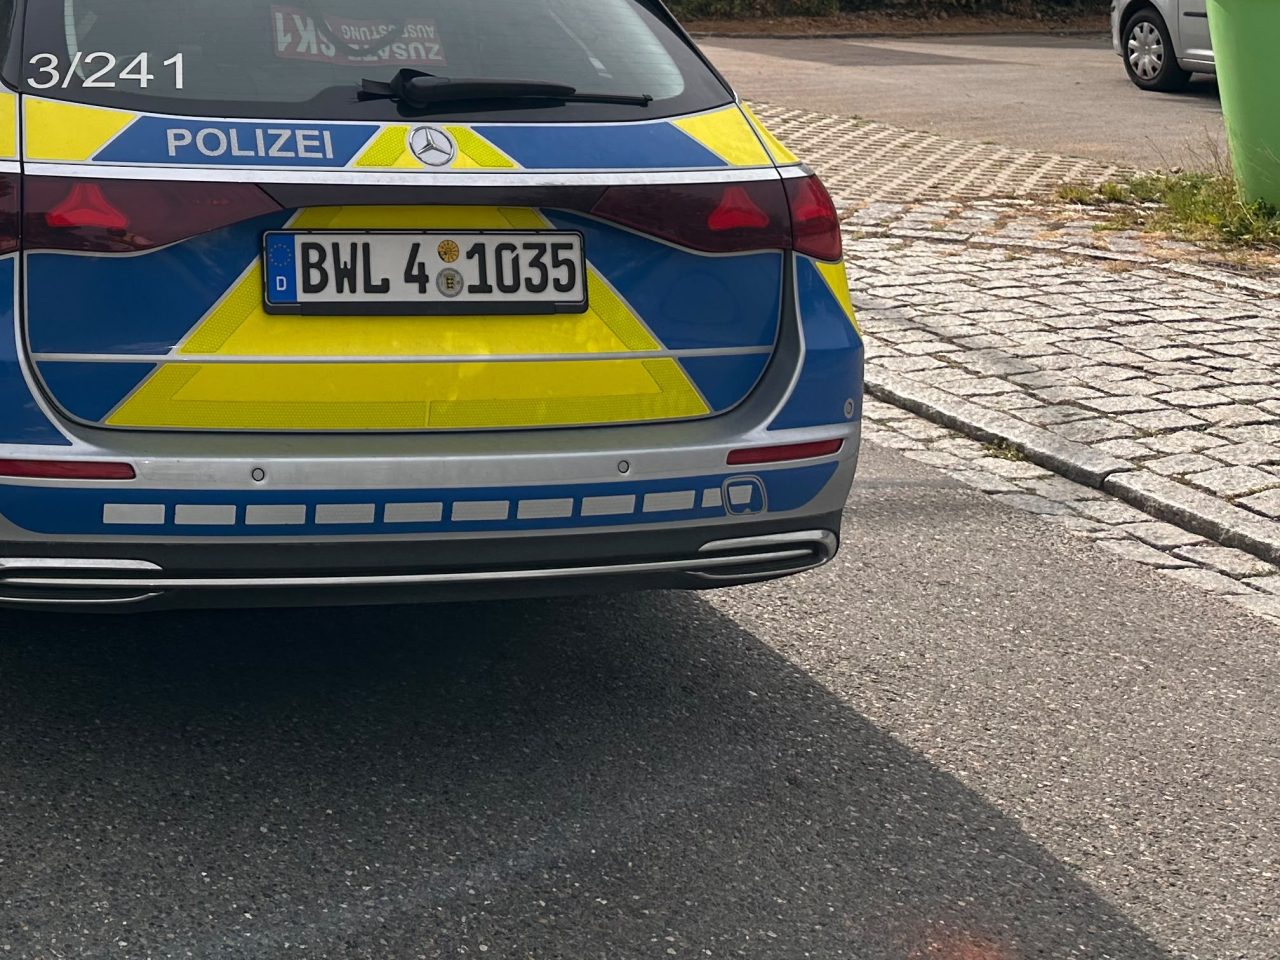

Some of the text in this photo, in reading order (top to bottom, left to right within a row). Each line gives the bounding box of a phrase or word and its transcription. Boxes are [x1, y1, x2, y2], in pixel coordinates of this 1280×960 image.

[26, 51, 184, 90] 3/241
[165, 127, 334, 159] POLIZEI
[276, 242, 577, 294] D BWL 4 1035
